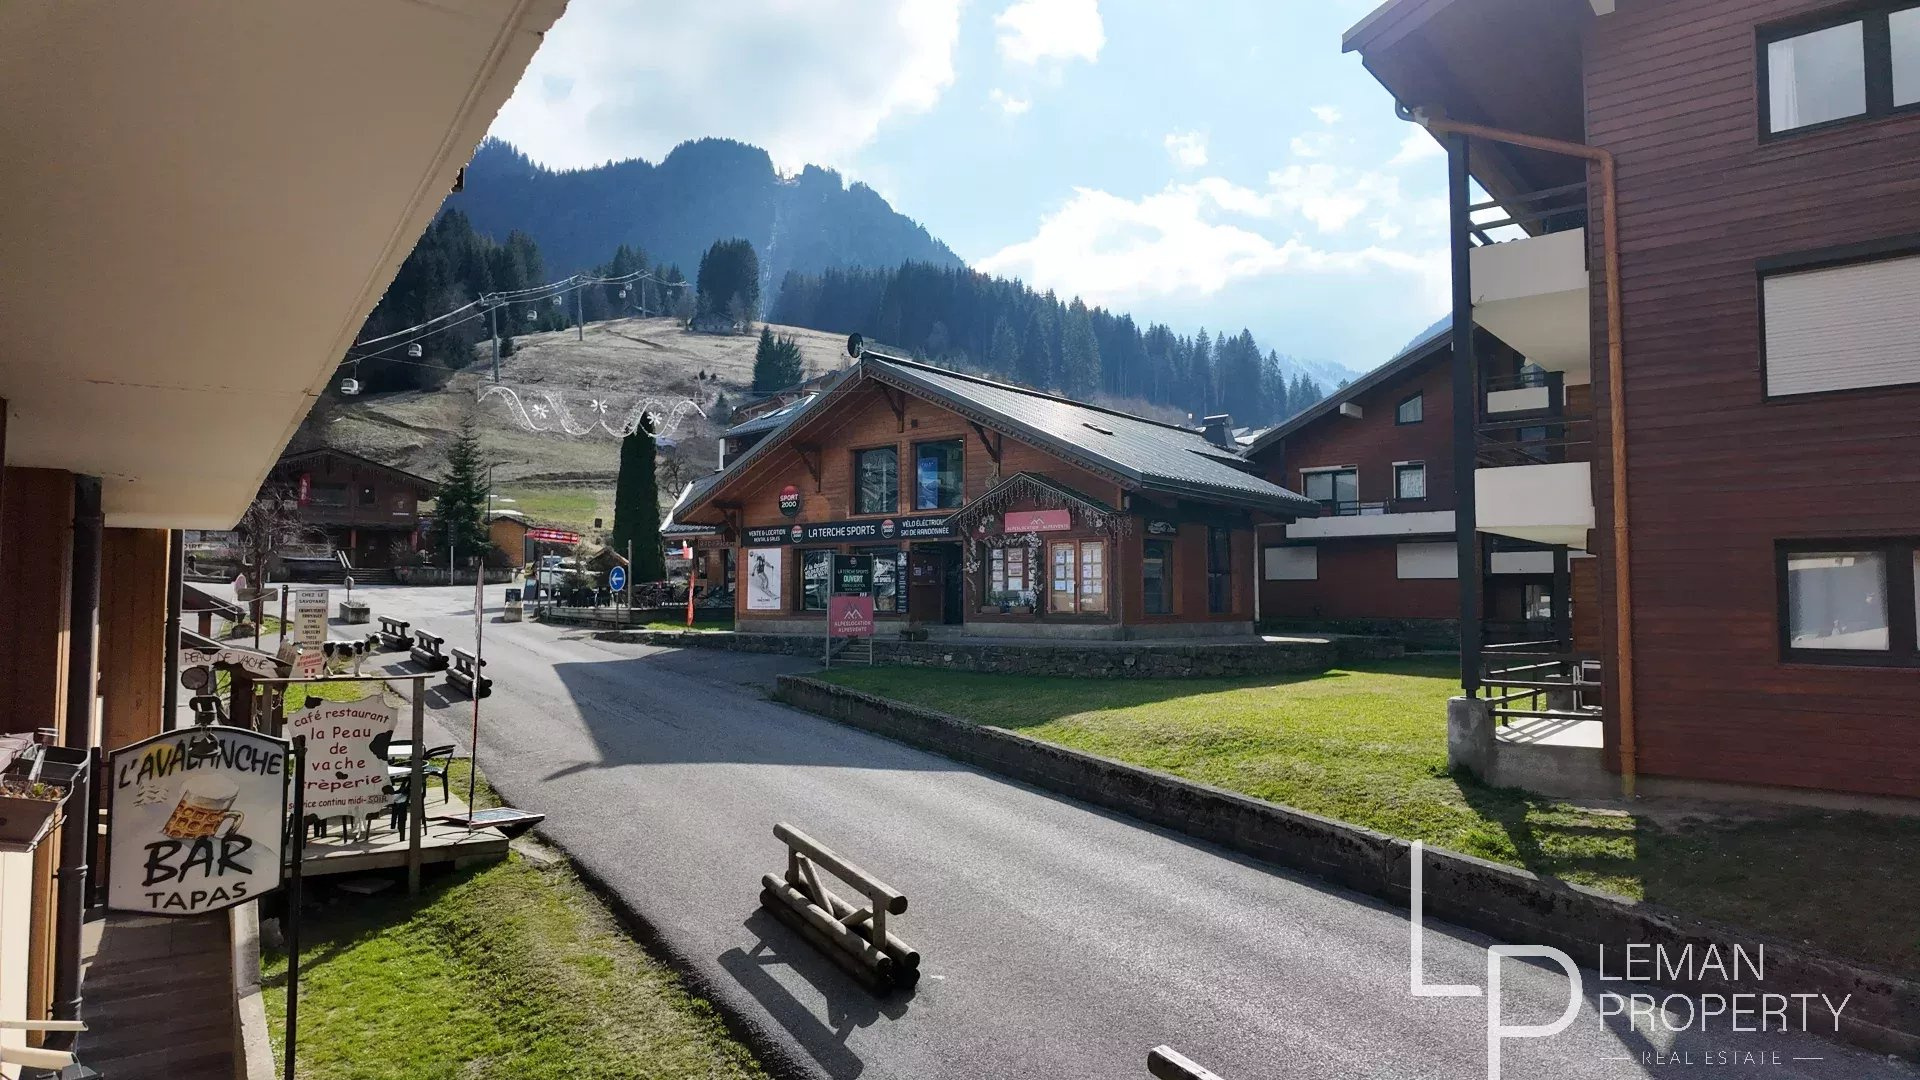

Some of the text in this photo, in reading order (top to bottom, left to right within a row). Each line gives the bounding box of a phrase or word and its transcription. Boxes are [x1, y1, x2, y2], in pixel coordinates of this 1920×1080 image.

[766, 528, 786, 536] LOCATION
[808, 524, 876, 538] LA TERCHE SPORTS
[917, 526, 950, 536] RANDONNÉE
[843, 575, 863, 583] OUVERT
[184, 652, 212, 663] PEAU
[294, 708, 389, 727] café restaurant
[311, 726, 371, 740] la Peau
[329, 742, 348, 755] de
[312, 756, 366, 771] vache
[303, 775, 382, 792] rèperie
[318, 798, 346, 808] continu
[141, 834, 253, 887] BAR
[144, 881, 248, 910] TAPAS
